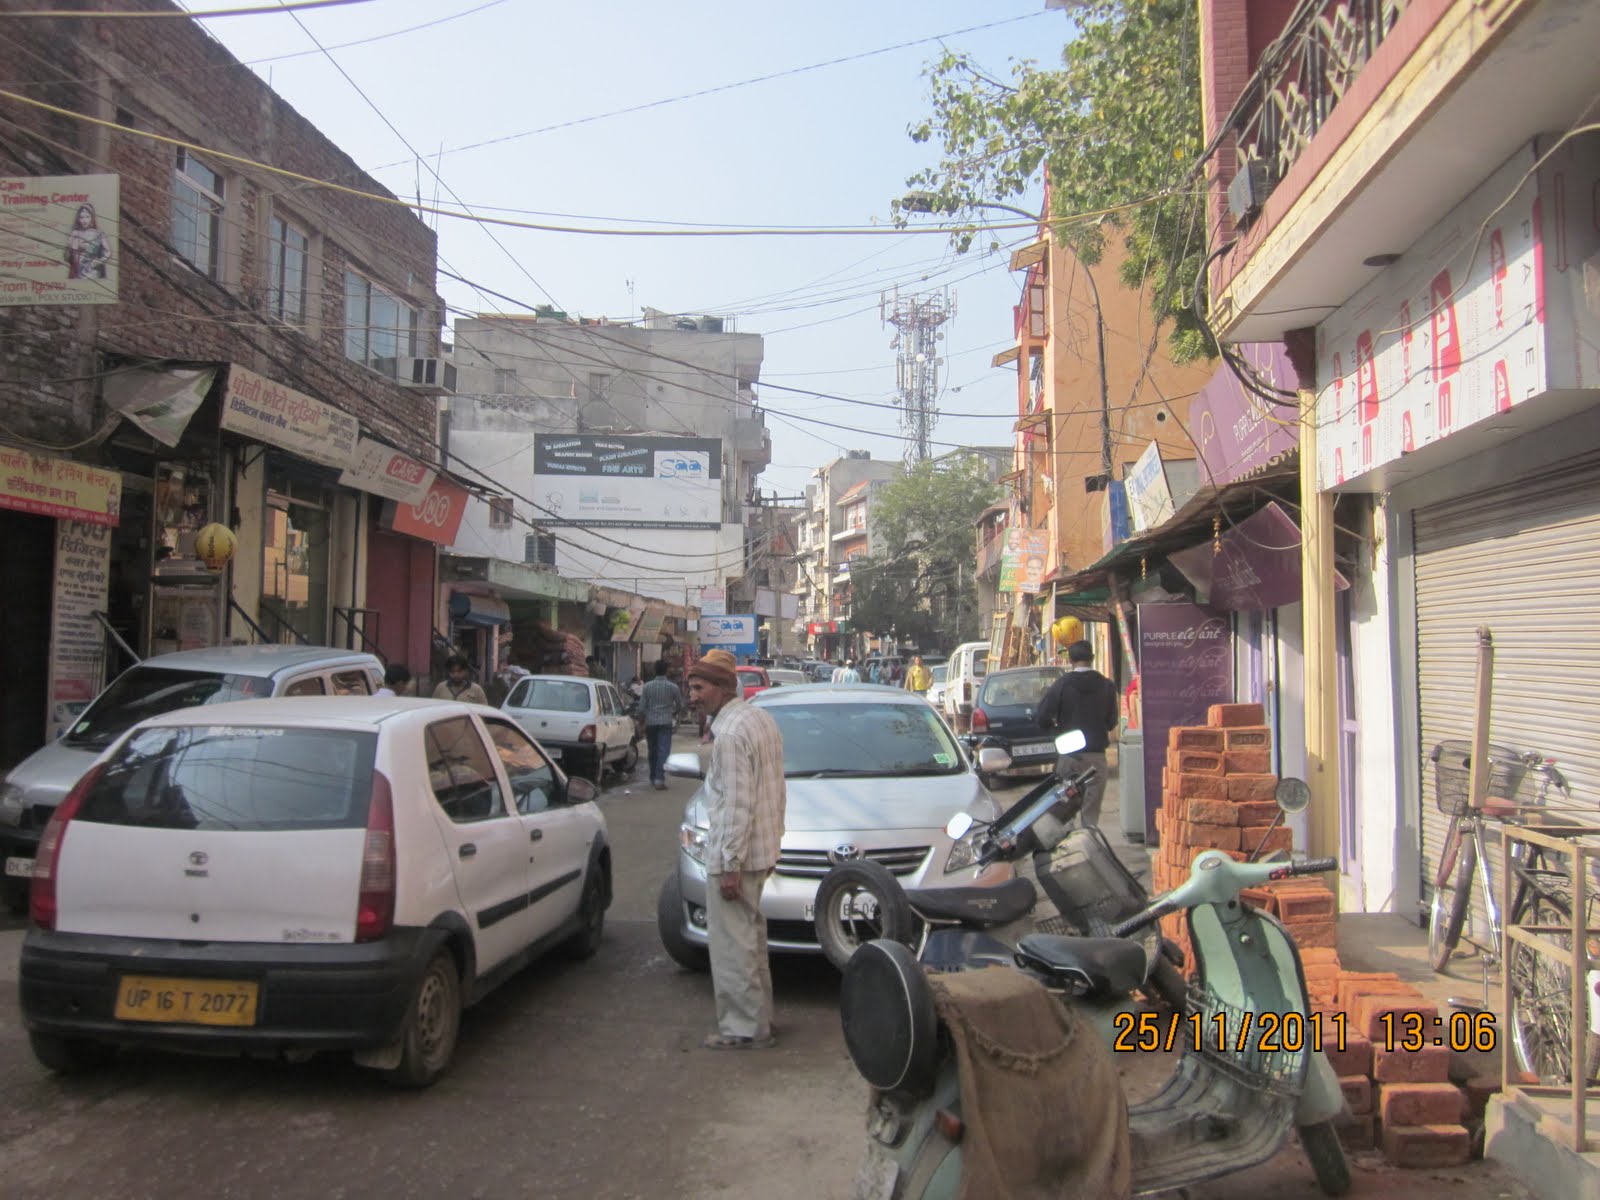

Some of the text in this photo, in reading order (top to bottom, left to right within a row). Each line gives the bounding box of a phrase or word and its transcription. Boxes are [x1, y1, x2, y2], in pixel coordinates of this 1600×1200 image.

[2, 192, 90, 206] Training Center
[1430, 267, 1463, 440] ALE
[1356, 328, 1380, 472] ALE
[389, 457, 423, 483] CARE
[1143, 631, 1177, 641] PURPLE
[125, 988, 251, 1013] UP 16 T 2077
